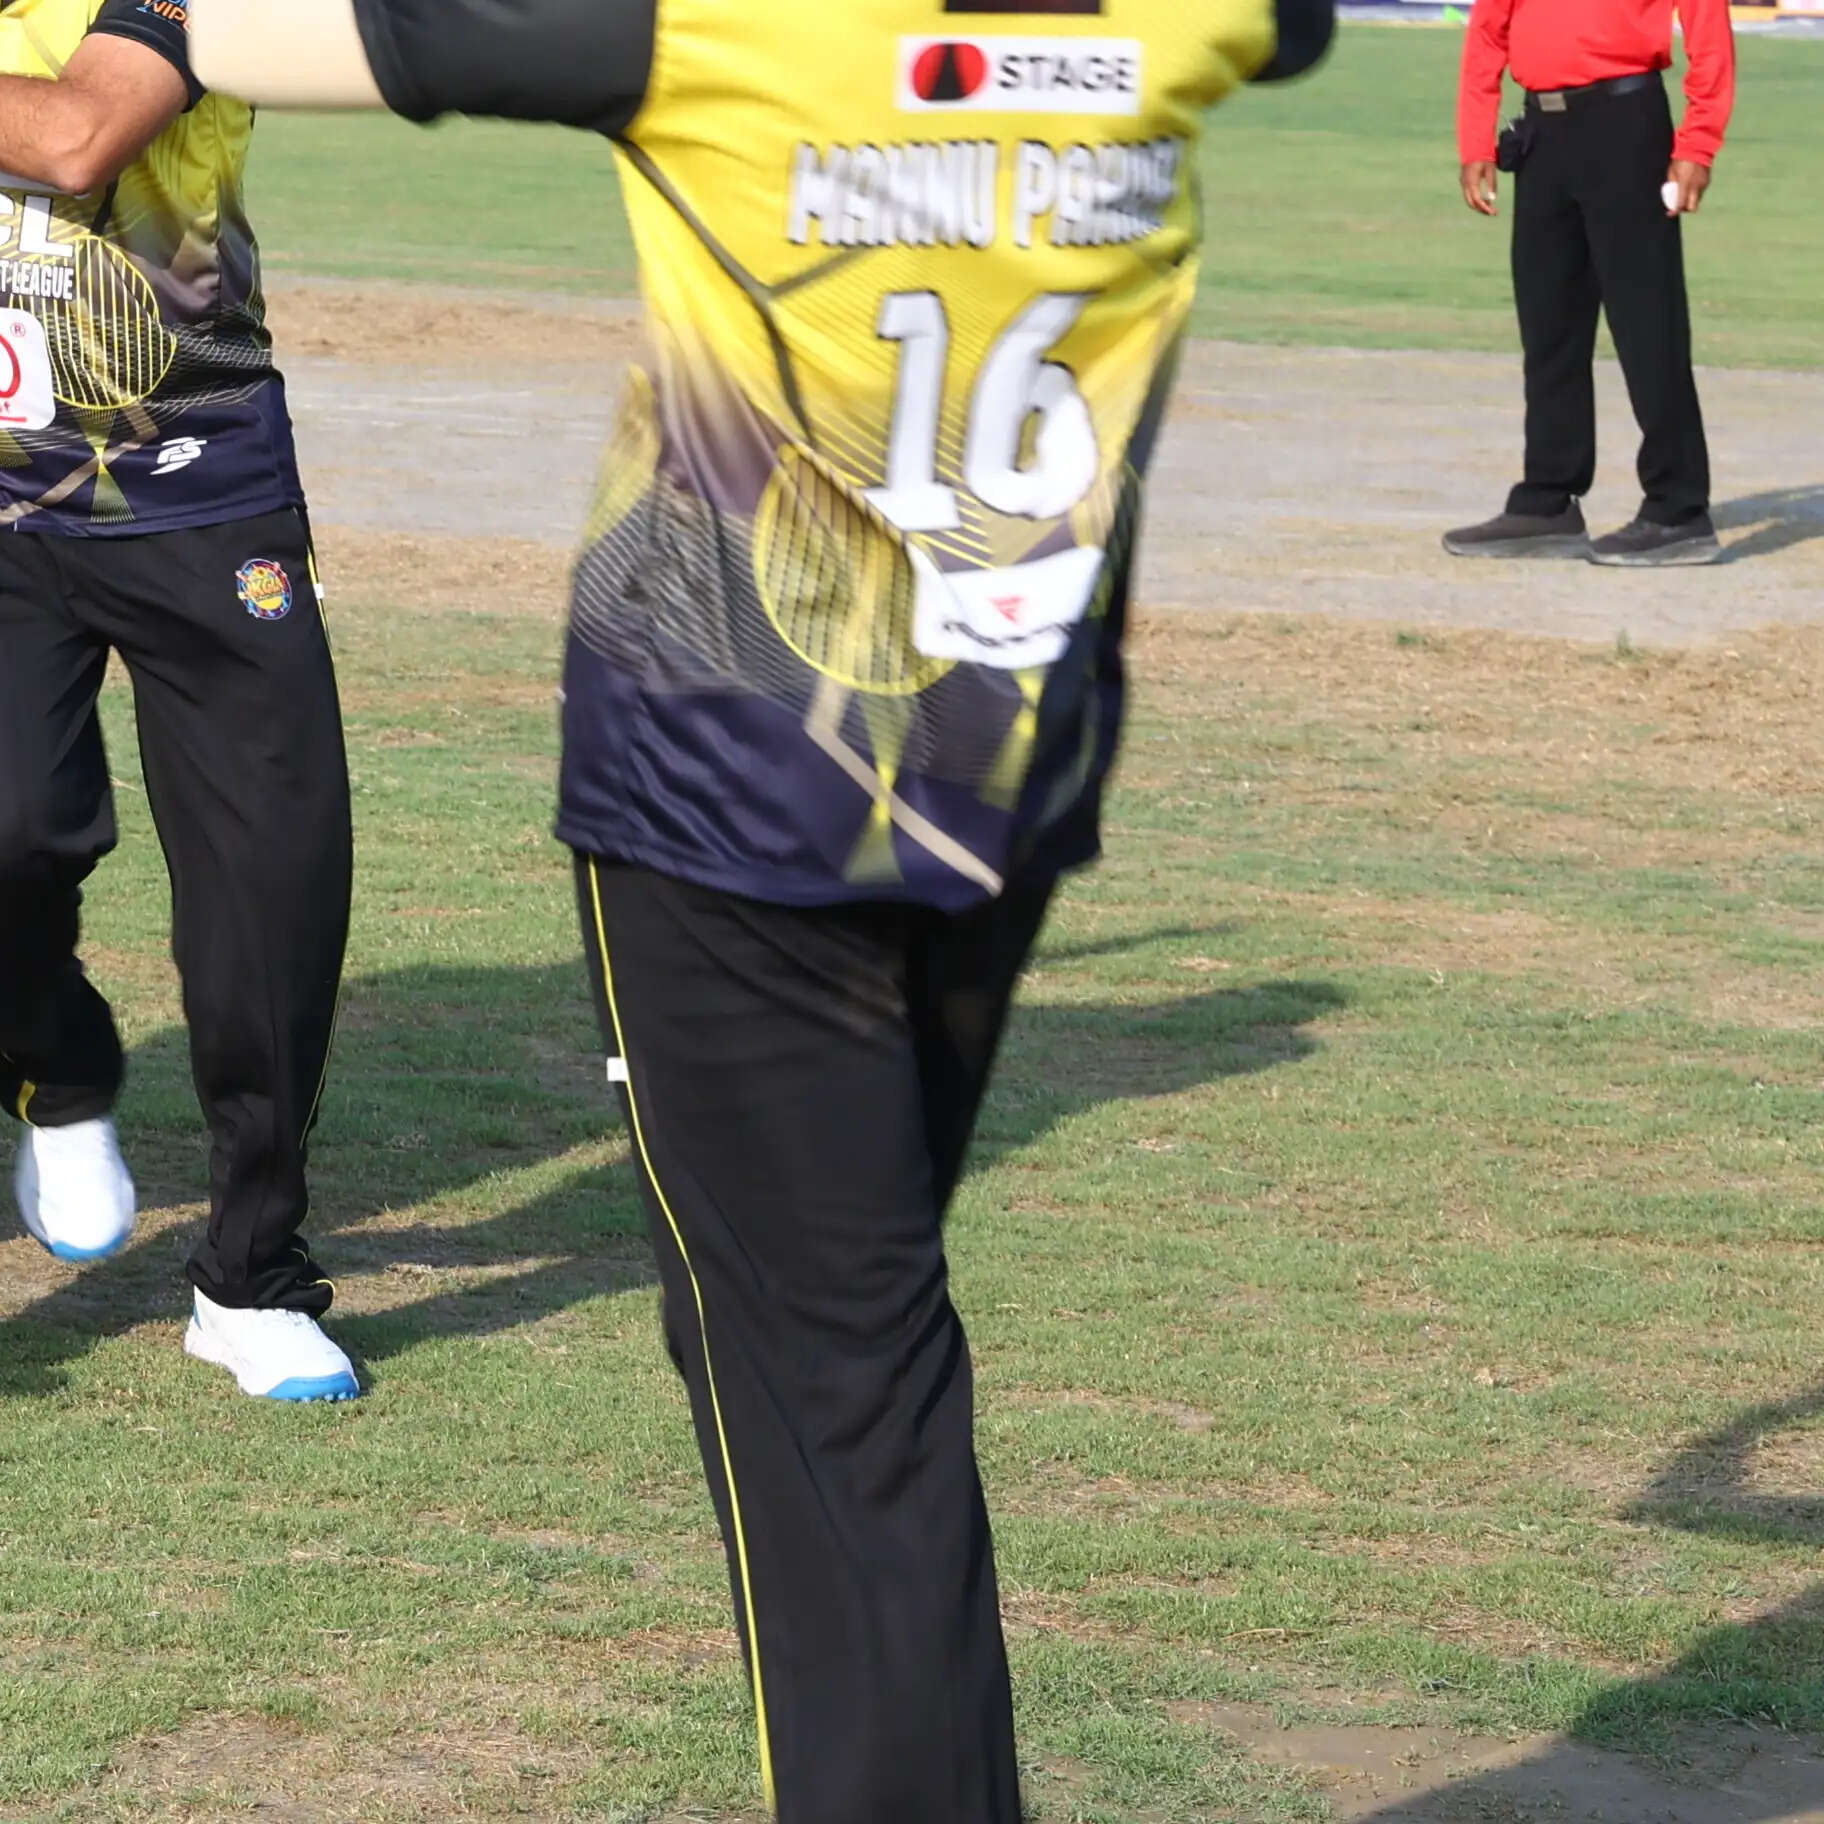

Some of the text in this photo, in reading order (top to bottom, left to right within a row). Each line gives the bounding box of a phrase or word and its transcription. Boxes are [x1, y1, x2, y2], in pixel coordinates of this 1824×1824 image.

[998, 54, 1135, 92] STAGE
[11, 260, 74, 301] LEAGUE
[865, 290, 1100, 532] 16
